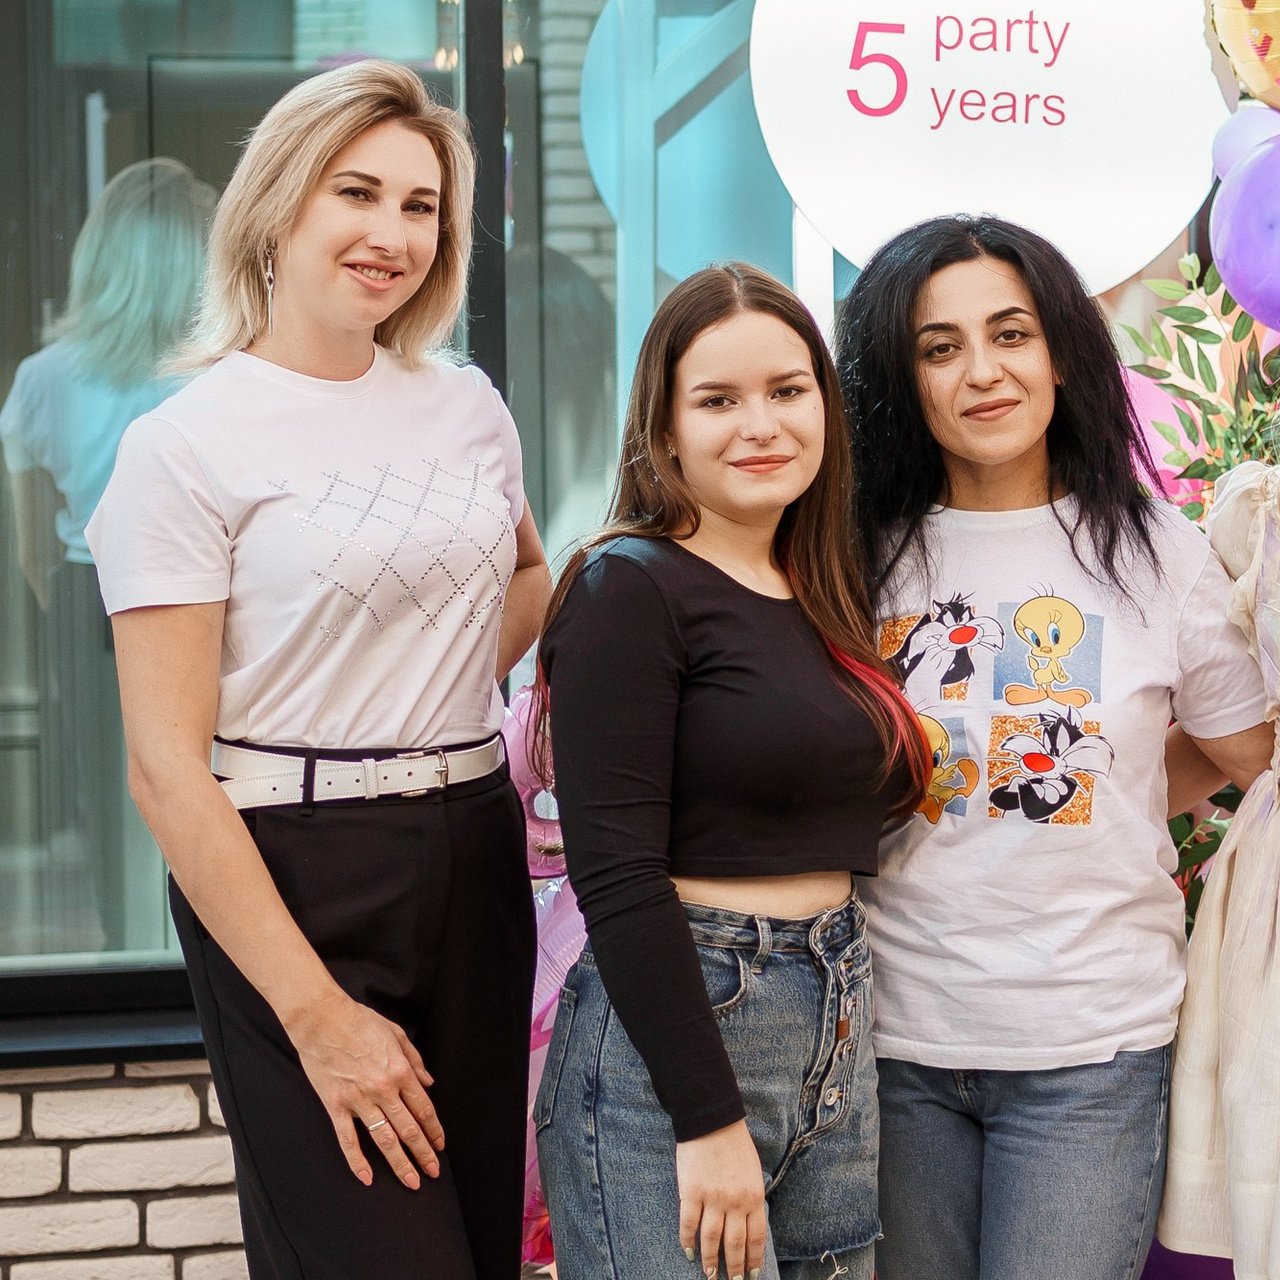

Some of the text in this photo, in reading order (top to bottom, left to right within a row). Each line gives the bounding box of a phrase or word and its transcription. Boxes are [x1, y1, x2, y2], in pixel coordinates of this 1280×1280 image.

[846, 21, 1066, 130] 5 years
[935, 10, 1070, 68] party
